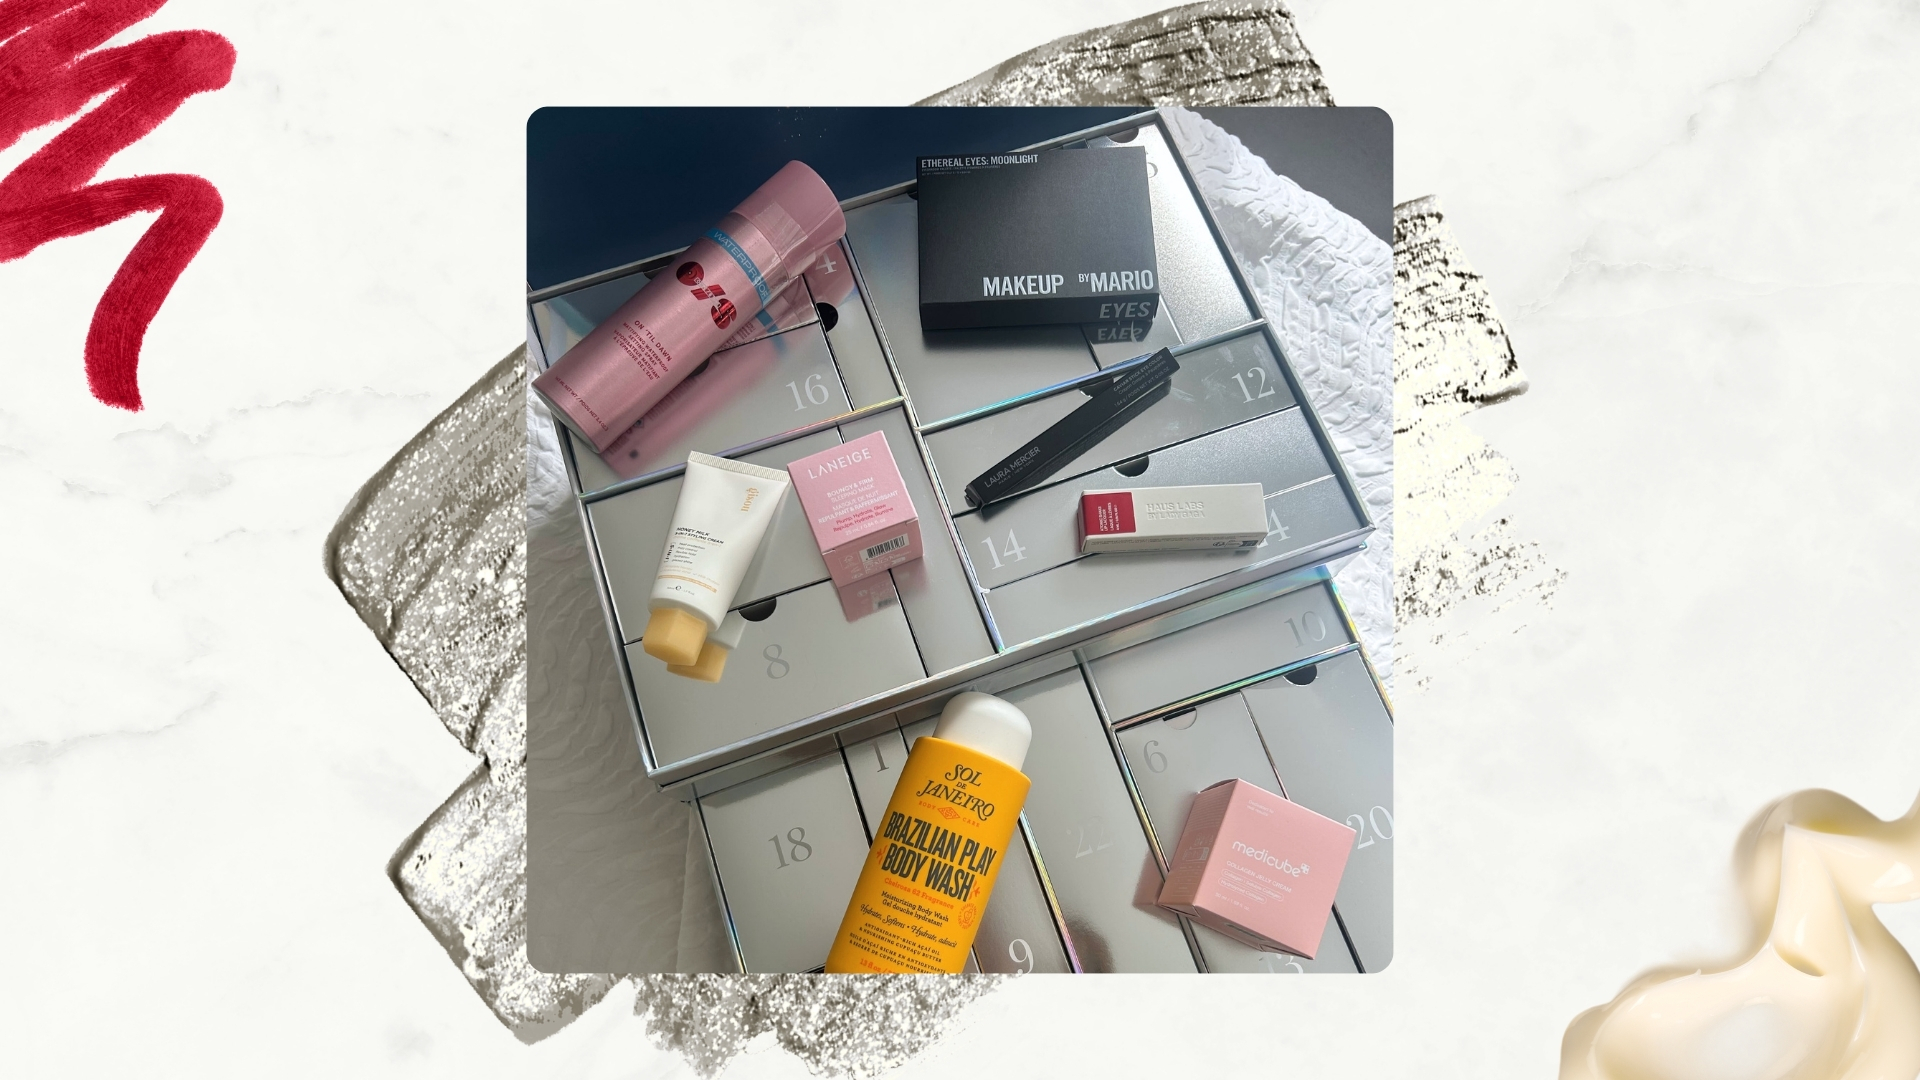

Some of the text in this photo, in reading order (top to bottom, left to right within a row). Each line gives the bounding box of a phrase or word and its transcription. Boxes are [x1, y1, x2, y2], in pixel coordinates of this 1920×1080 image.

[921, 154, 1038, 168] ETHEREAL EYES: MOONLIGHT
[714, 231, 770, 298] WATERPROOF
[983, 269, 1154, 297] MAKEUP BY MARIO
[1100, 302, 1151, 319] EYES
[624, 323, 668, 372] MATTIFYING WATERPROOF
[628, 335, 657, 365] SETTING SPRAY
[634, 320, 644, 330] ON
[656, 342, 672, 361] DAWN
[786, 374, 829, 412] 16
[1114, 379, 1129, 391] CAVIAR
[1128, 371, 1141, 380] STICK
[1232, 366, 1276, 404] 12
[808, 448, 872, 480] LANEIGE
[985, 447, 1040, 487] LAURA MERCIER
[827, 485, 854, 497] BOUNCY
[859, 477, 873, 486] FIRM
[833, 499, 856, 511] MASQUE
[866, 490, 878, 499] NUIT
[1146, 501, 1204, 513] HAUS LABS
[981, 528, 1027, 570] 14
[1284, 610, 1326, 648] 10
[763, 644, 790, 680] 8
[872, 739, 890, 772] 1
[1143, 740, 1168, 774] 6
[944, 764, 982, 787] SOL
[956, 782, 967, 790] DE
[916, 780, 995, 821] JANEIRO
[918, 800, 980, 828] BODY CARE
[1346, 805, 1394, 849] 20
[768, 826, 813, 870] 18
[884, 811, 997, 876] BRAZILIAN PLAY
[1233, 842, 1303, 877] medicube
[881, 842, 975, 902] BODY WASH
[1227, 861, 1292, 893] COLLAGEN JELLY CREAM
[881, 891, 916, 911] Moisturizing
[917, 905, 933, 916] Body
[934, 910, 949, 922] Wash
[884, 878, 911, 893] Cheirosa
[921, 892, 954, 910] Fragrance
[882, 899, 892, 908] Gel
[892, 902, 914, 916] douche
[914, 910, 943, 928] hydratant
[882, 915, 906, 929] Softens
[863, 928, 895, 946] NOURISHING
[922, 952, 942, 963] BUTTER
[864, 922, 916, 947] ANTIOXIDANT-RICH
[860, 958, 867, 967] 13
[880, 945, 897, 957] RICHE
[1008, 938, 1033, 974] 9
